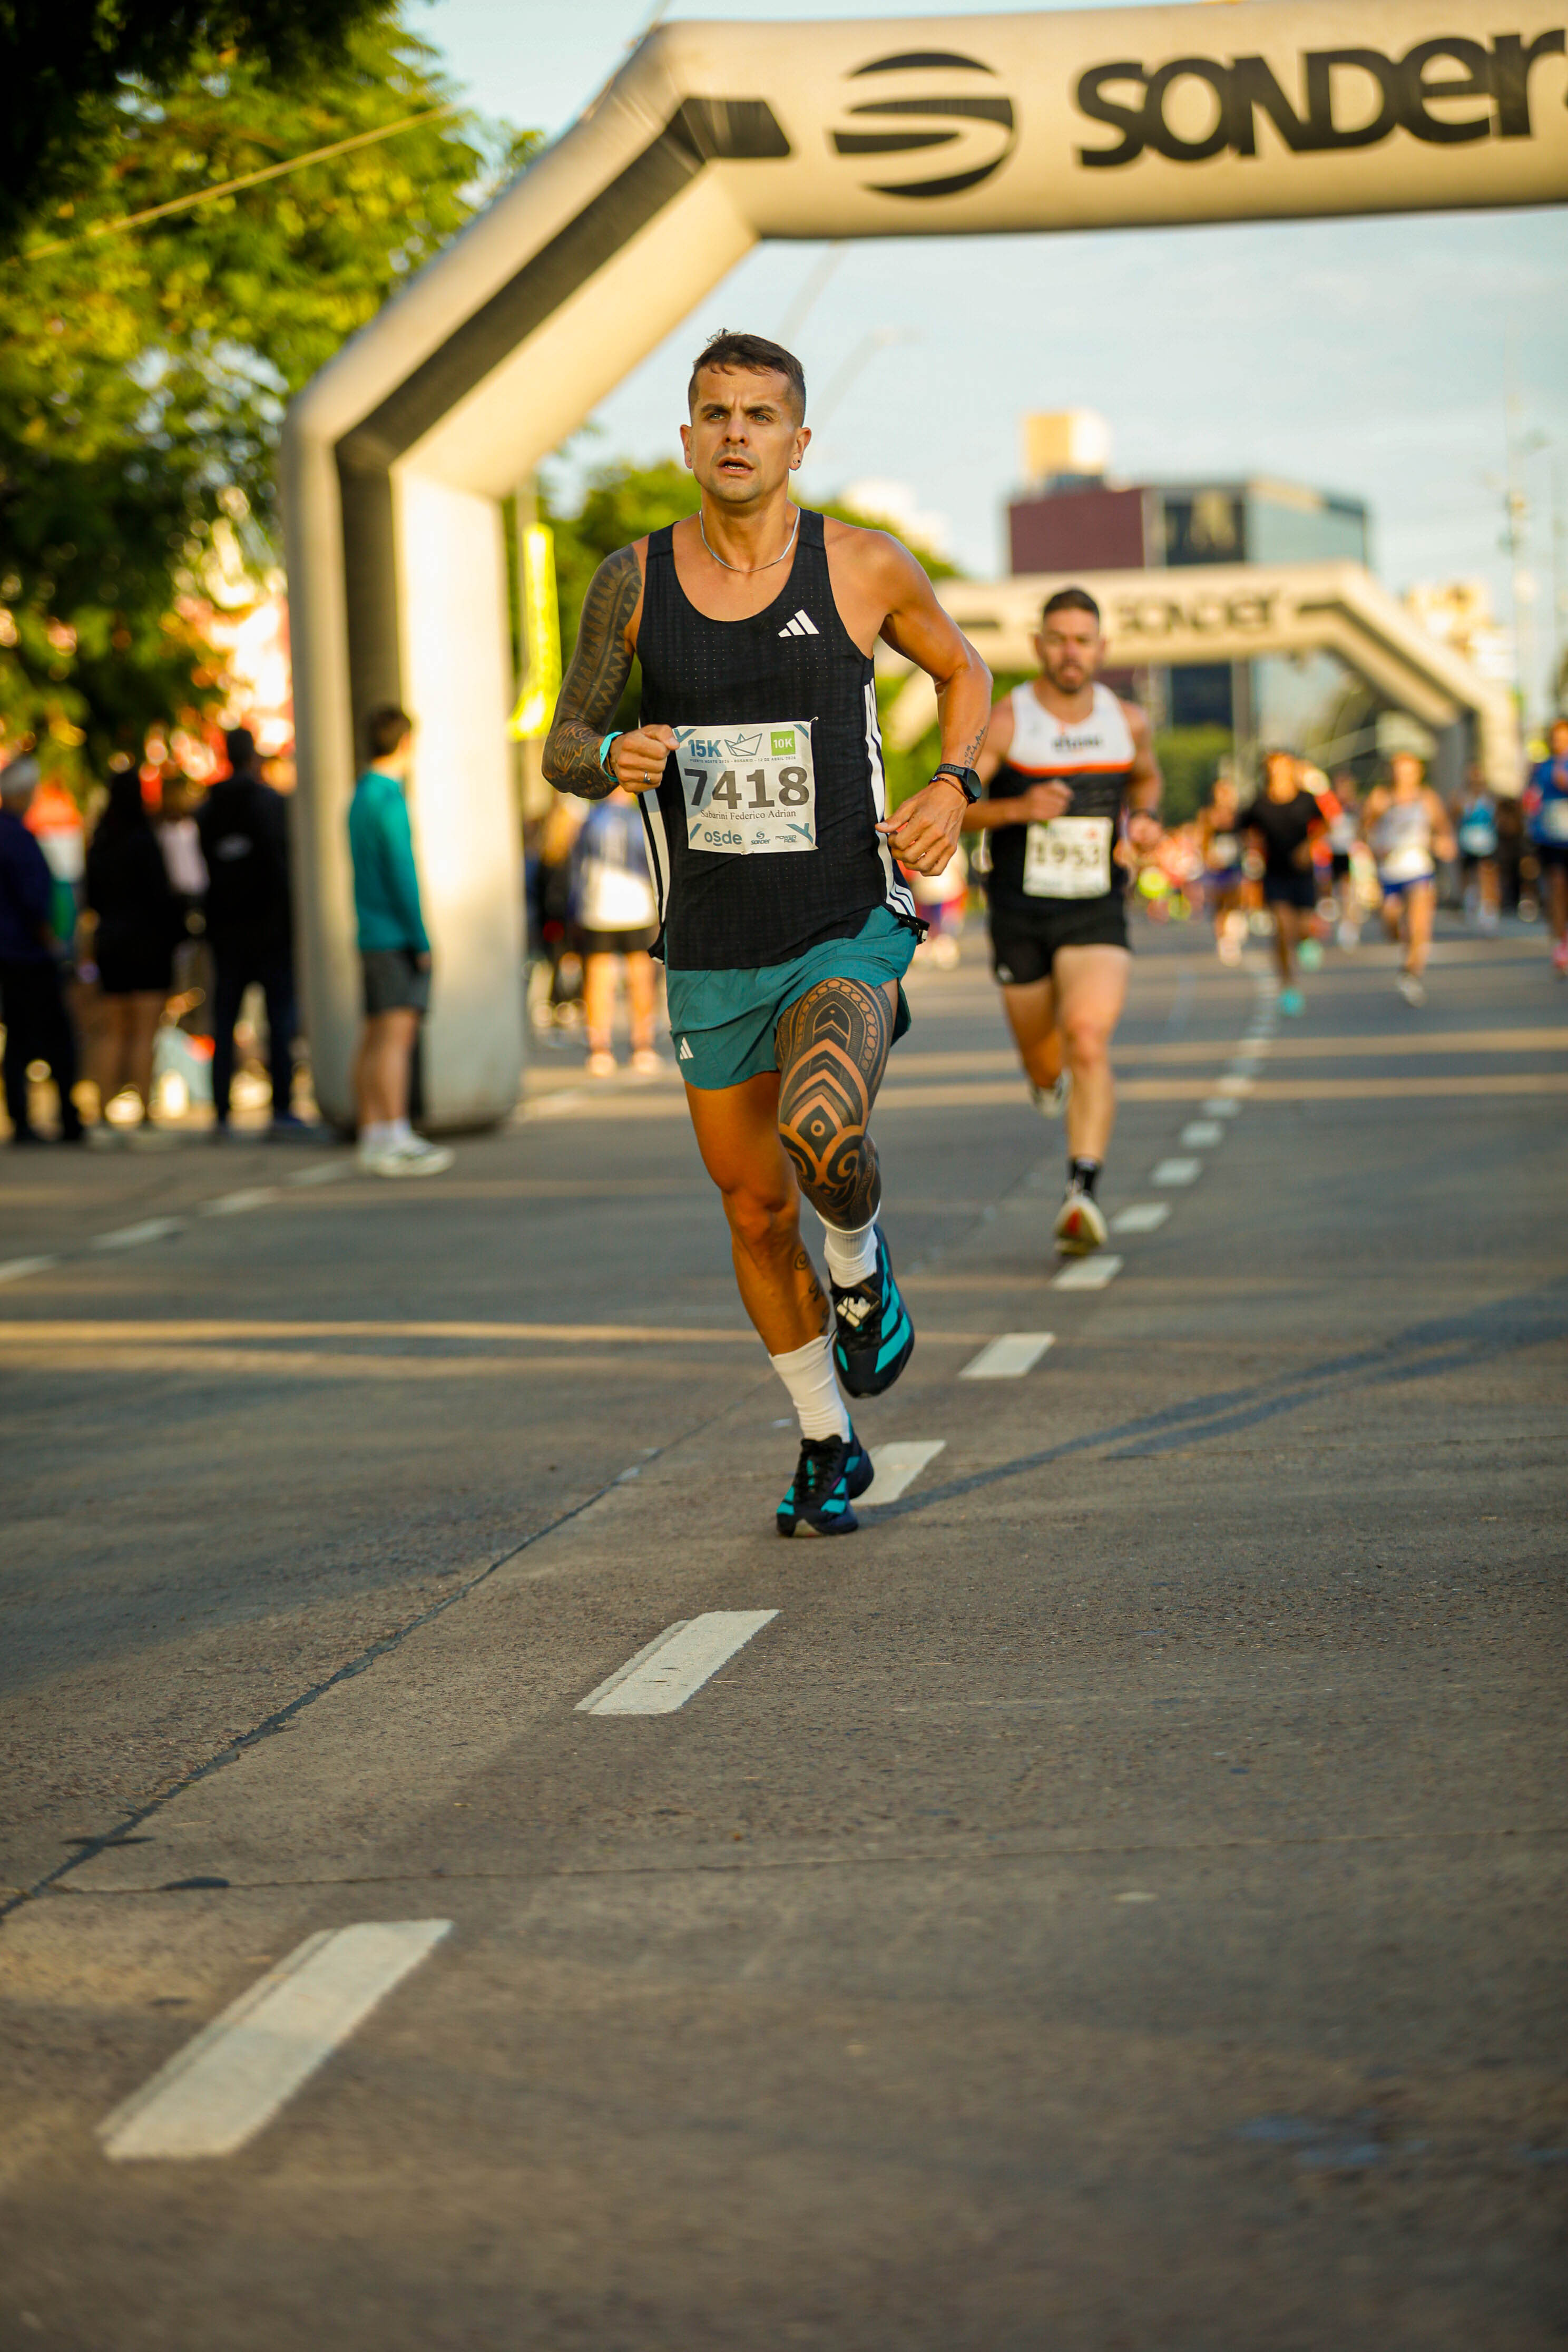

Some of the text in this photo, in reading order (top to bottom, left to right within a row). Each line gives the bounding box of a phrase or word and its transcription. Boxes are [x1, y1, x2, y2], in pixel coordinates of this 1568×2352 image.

[688, 739, 722, 758] 15K
[773, 739, 793, 749] 10K
[683, 766, 810, 809] 7418
[700, 809, 797, 820] Sabarini Federico Adrian
[704, 829, 742, 846] osde
